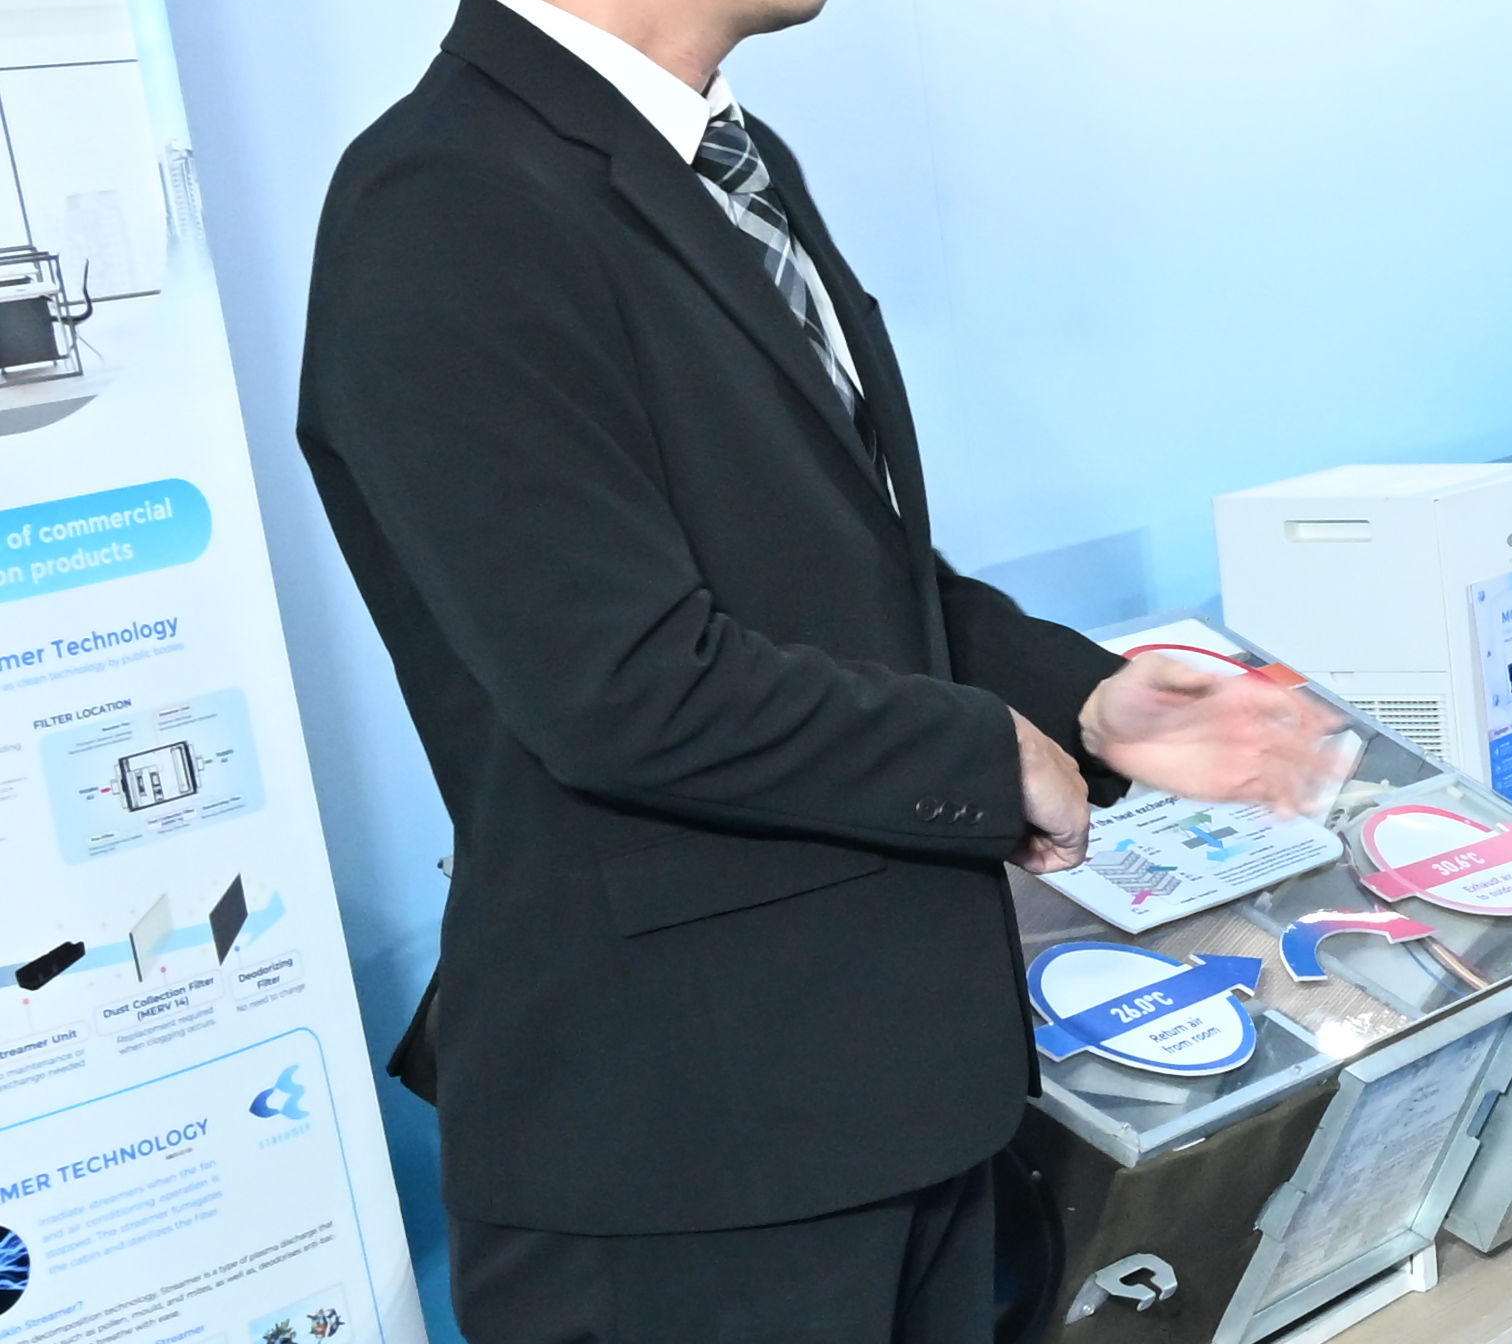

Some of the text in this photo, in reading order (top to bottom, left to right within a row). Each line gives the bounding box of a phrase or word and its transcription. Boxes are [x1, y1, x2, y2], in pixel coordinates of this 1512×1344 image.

[7, 496, 174, 549] of commercial
[30, 542, 134, 585] products
[50, 616, 179, 660] Technology
[33, 712, 74, 731] FILTER
[76, 698, 133, 721] LOCATION
[1431, 851, 1486, 877] 30.6°C
[1462, 875, 1501, 895] Exhaust
[237, 957, 295, 984] Deodorizing
[257, 974, 281, 990] Filter
[102, 976, 215, 1020] Dust Collection Filter
[1109, 990, 1175, 1025] 26.0°C
[51, 1027, 79, 1046] Unit
[1148, 1015, 1204, 1044] Return air
[1161, 1025, 1223, 1055] from room
[56, 1117, 208, 1183] TECHNOLOGY
